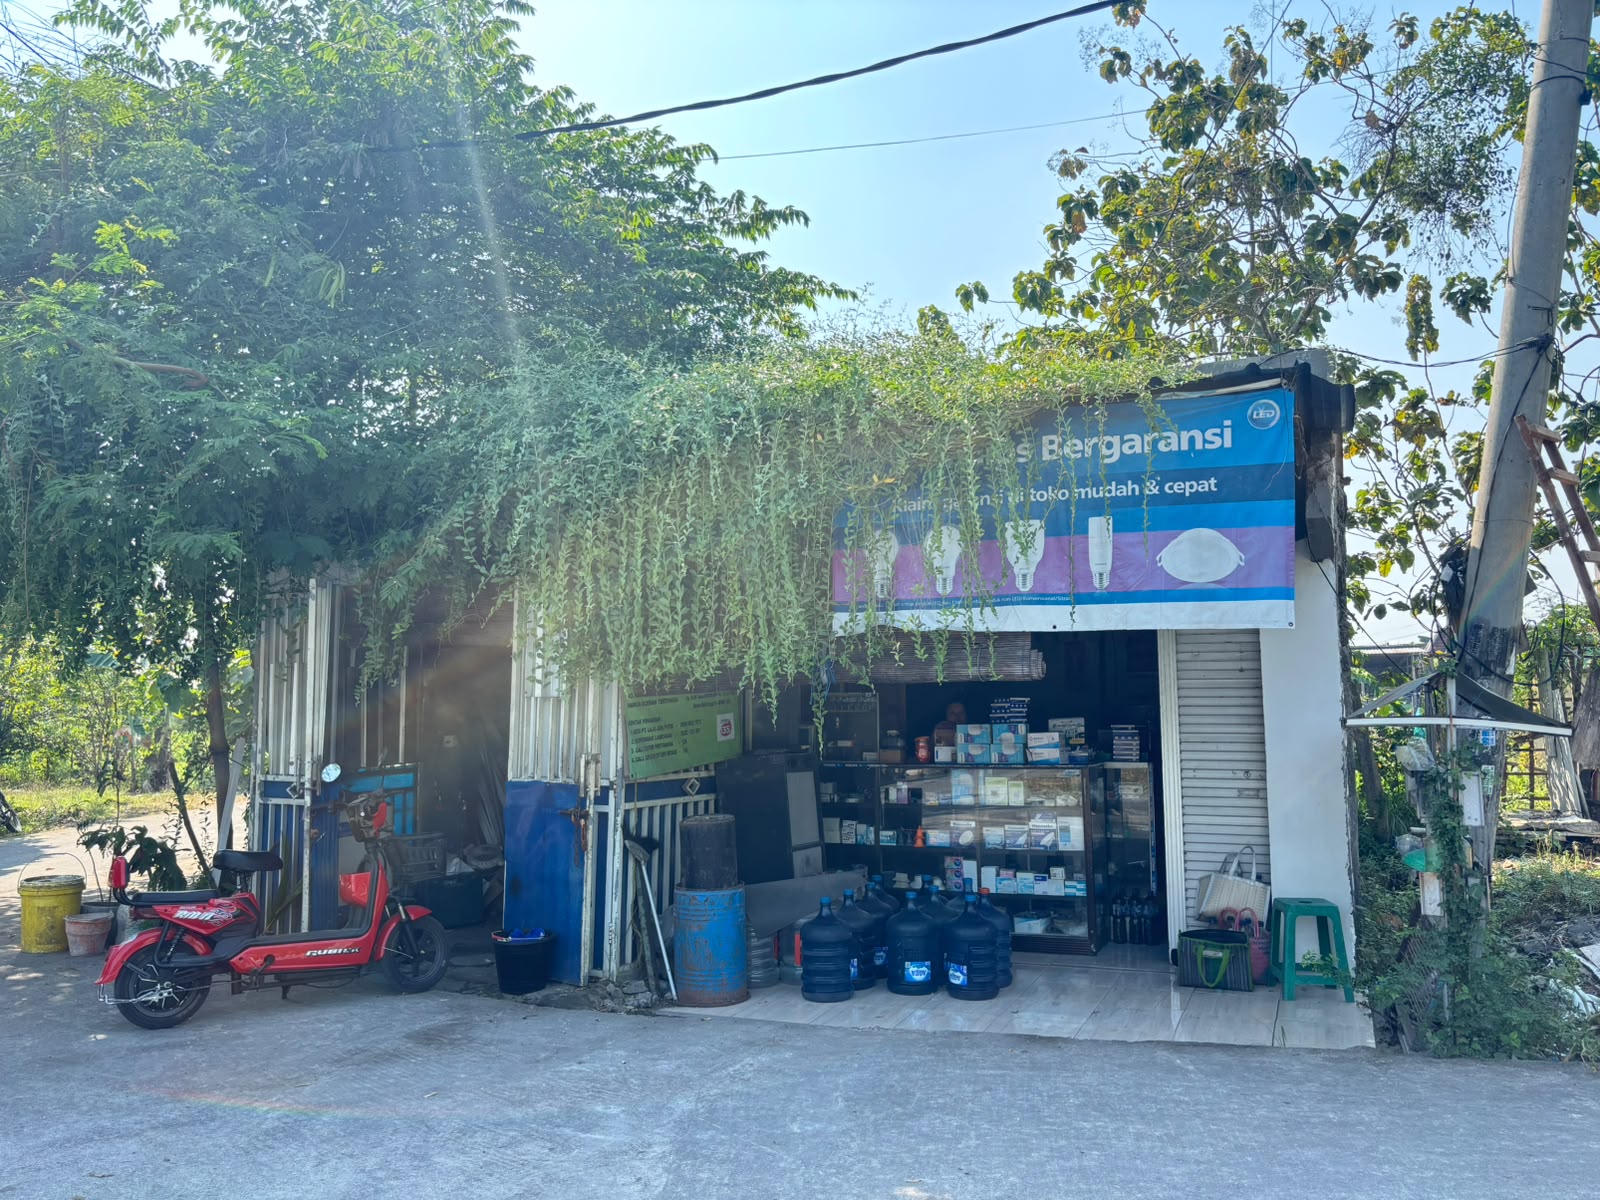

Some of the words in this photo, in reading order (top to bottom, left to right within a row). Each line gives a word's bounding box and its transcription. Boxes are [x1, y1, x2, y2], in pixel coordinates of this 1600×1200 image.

[1042, 419, 1233, 463] Bergaransi
[1029, 485, 1069, 502] toko
[1074, 480, 1140, 499] mudah
[1144, 478, 1160, 495] &
[1164, 476, 1218, 496] cepat
